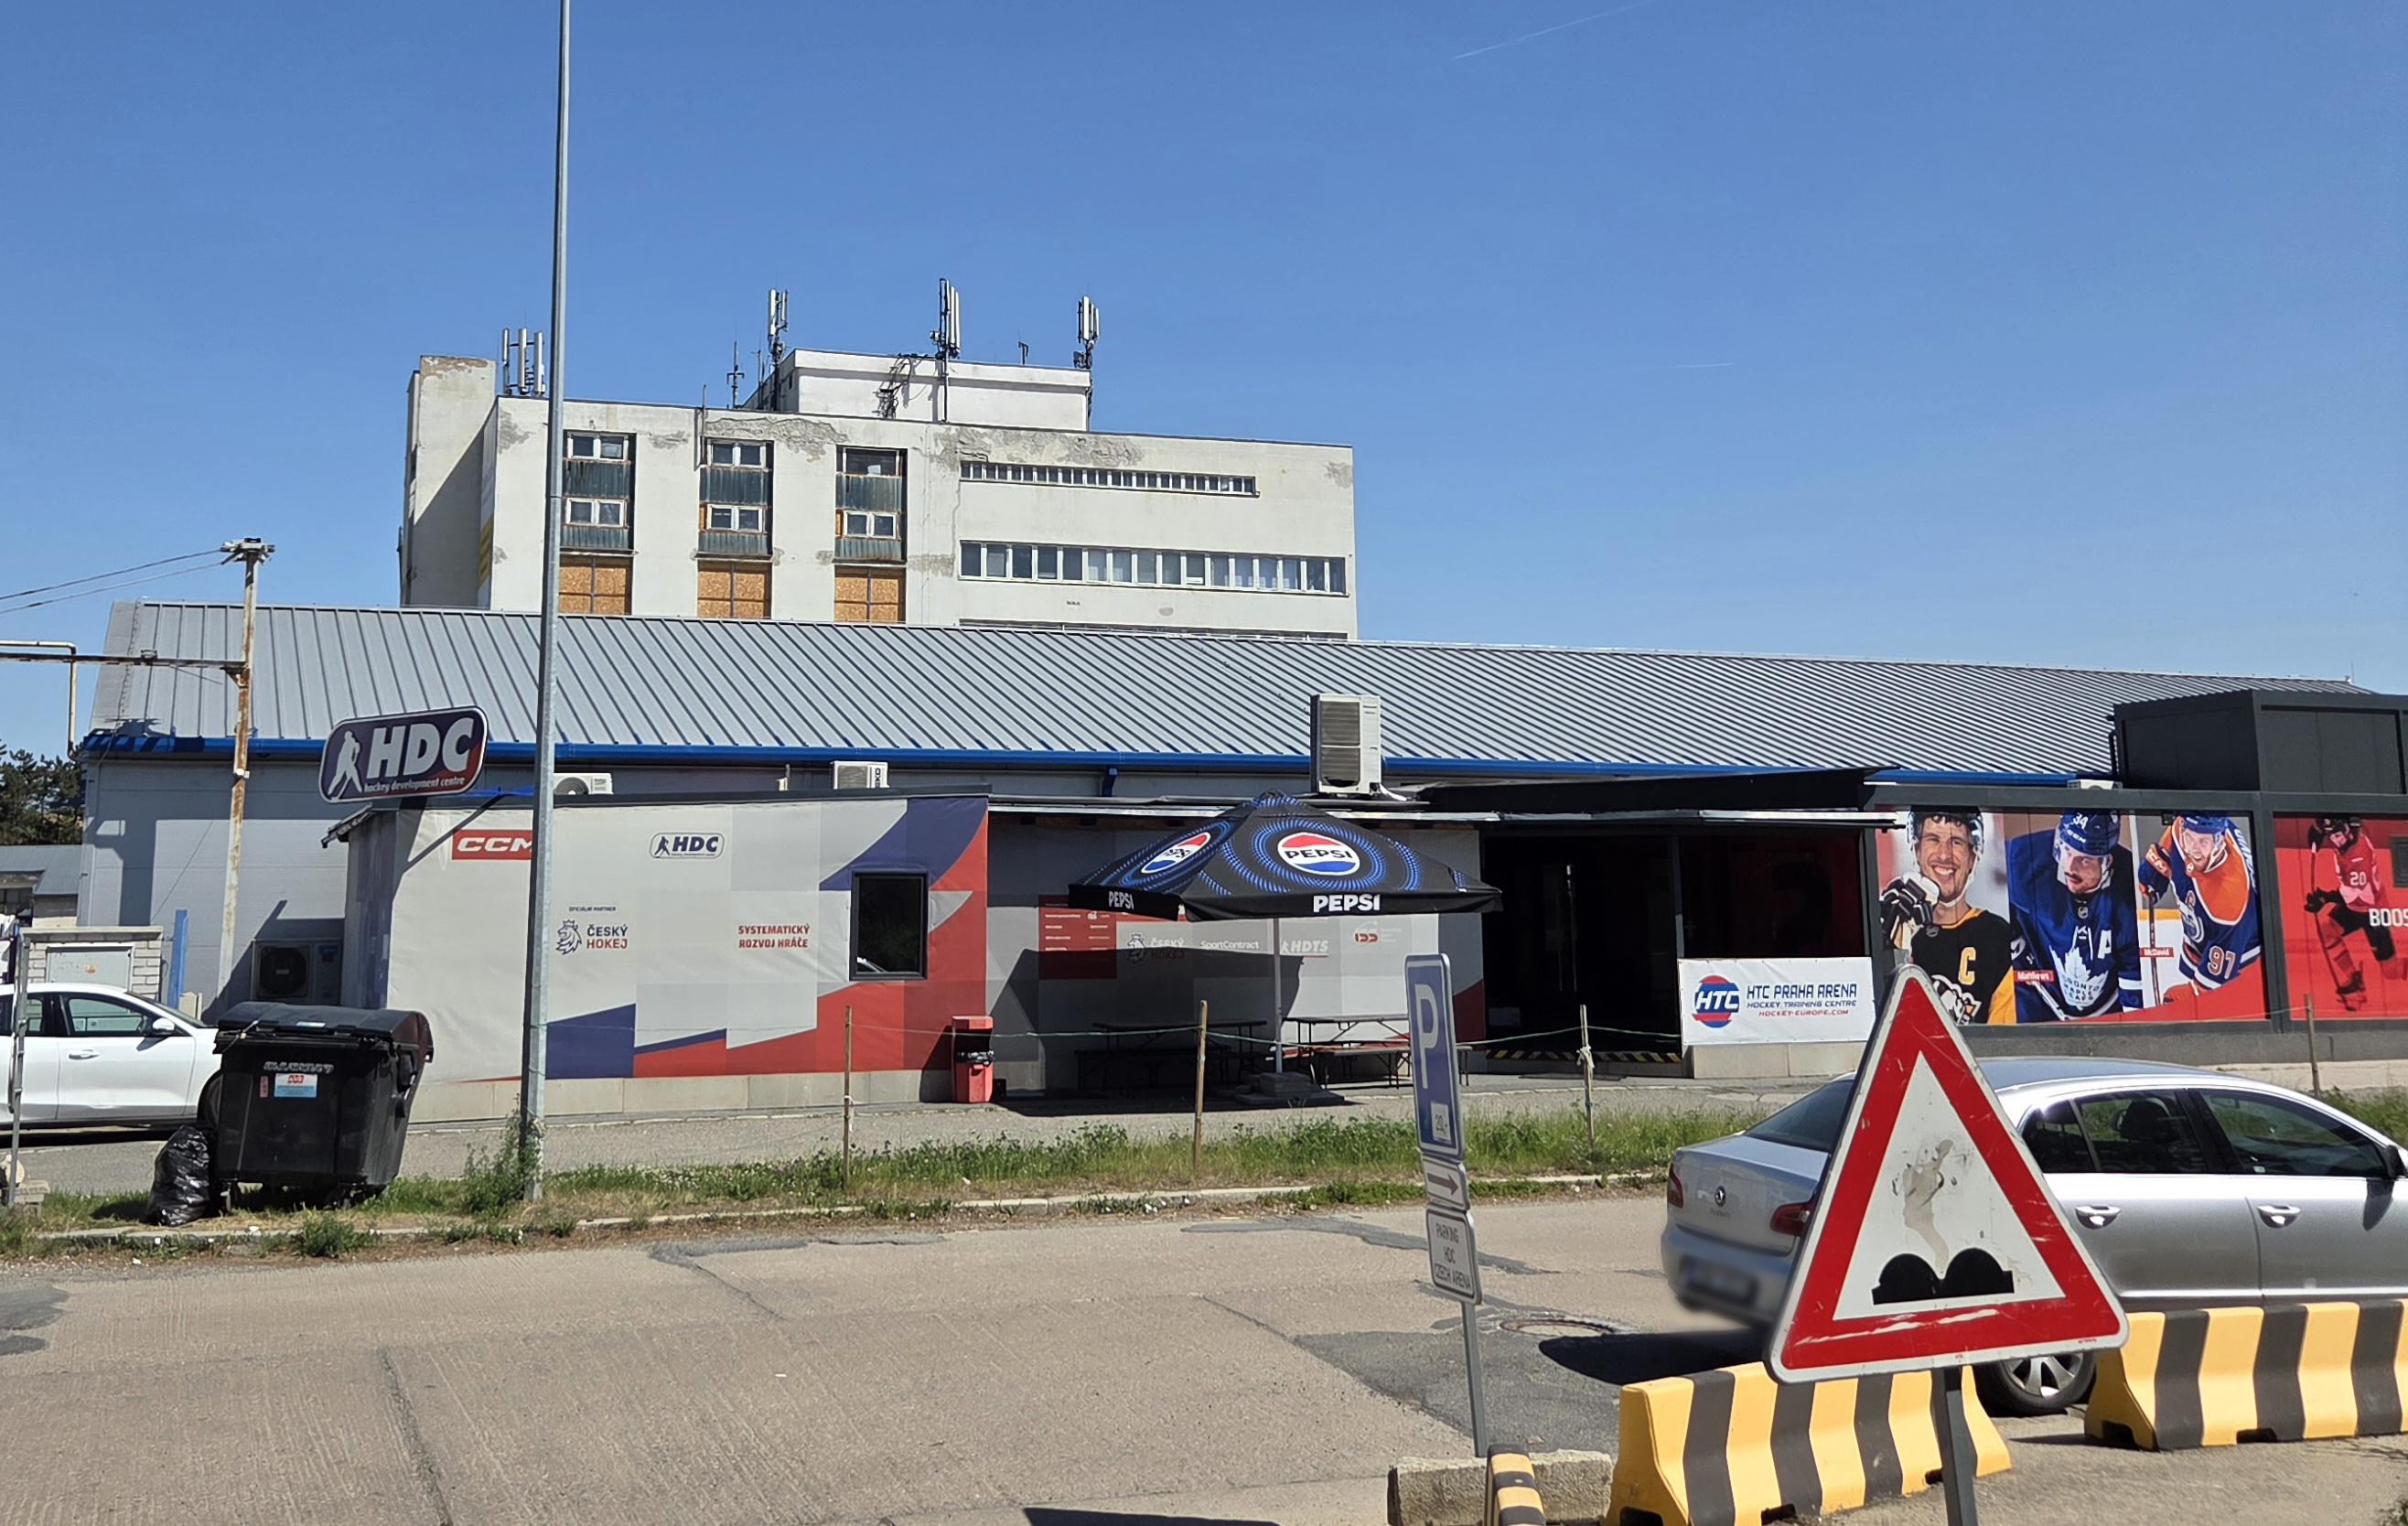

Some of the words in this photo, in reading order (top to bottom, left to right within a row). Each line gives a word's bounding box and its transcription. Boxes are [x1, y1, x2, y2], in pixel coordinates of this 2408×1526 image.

[367, 717, 476, 779] HDC
[364, 781, 390, 794] hockey
[391, 778, 439, 791] development
[440, 776, 466, 787] centre
[2072, 812, 2089, 830] 34
[457, 837, 532, 852] CCM
[672, 836, 719, 853] HDC
[1285, 849, 1353, 859] PEPSI
[2349, 871, 2368, 887] 20
[1108, 891, 1134, 910] PEPSI
[1313, 894, 1381, 913] PEPSI
[586, 923, 629, 937] ČESKÝ
[738, 923, 810, 935] SYSTEMATICKÝ
[586, 939, 628, 949] HOKEJ
[739, 939, 775, 949] ROZVOJ
[778, 936, 809, 948] HRÁČE
[1200, 940, 1260, 951] SportContract
[1291, 940, 1329, 952] HDTS
[2097, 930, 2112, 960] A
[1958, 947, 1977, 985] C
[1747, 985, 1770, 999] HTC
[1774, 984, 1814, 999] PRAHA
[1818, 983, 1857, 998] ARENA
[1695, 991, 1739, 1010] HTC
[1758, 1009, 1849, 1017] HOCKEY-EUROPE.COM
[1414, 983, 1439, 1090] P
